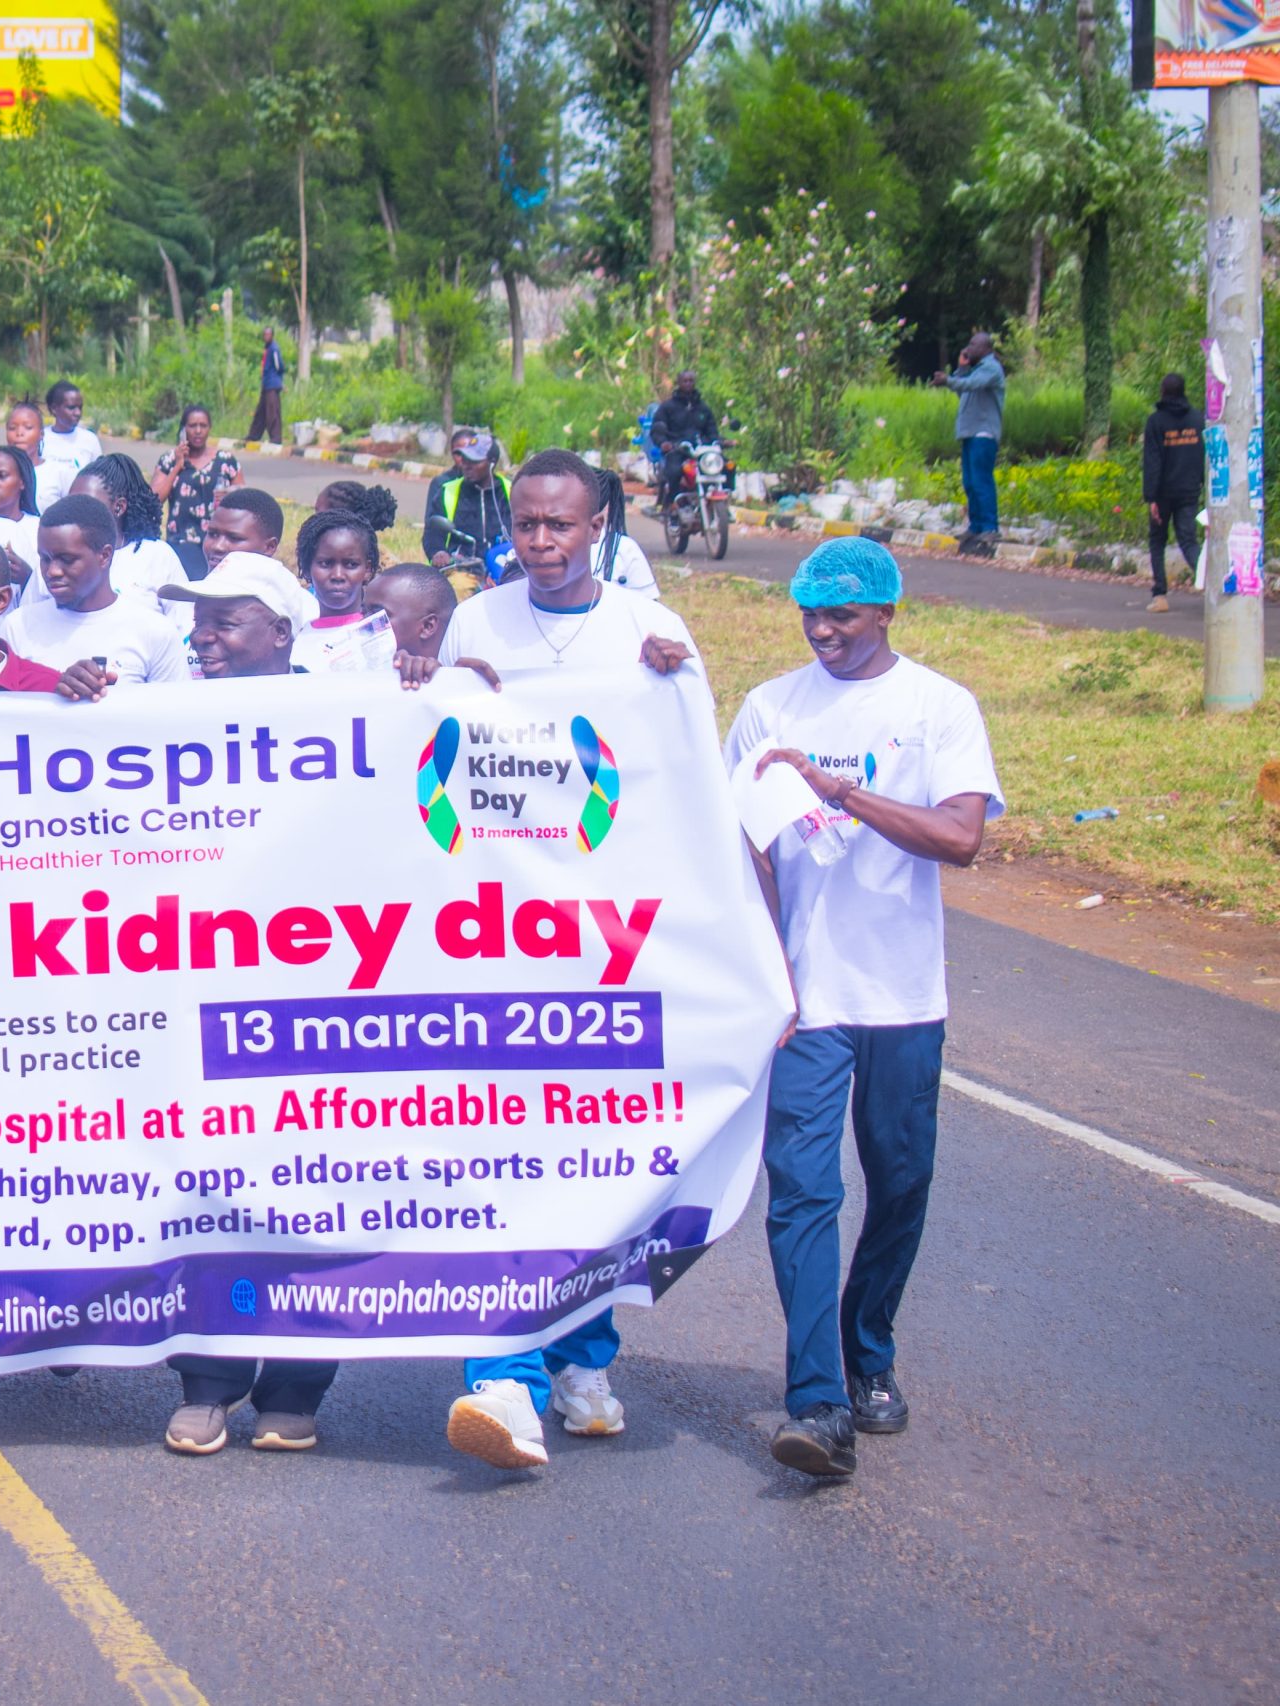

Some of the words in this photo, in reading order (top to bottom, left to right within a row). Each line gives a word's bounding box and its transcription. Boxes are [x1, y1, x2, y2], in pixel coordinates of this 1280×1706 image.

[467, 722, 556, 745] World
[468, 753, 573, 784] Kidney
[818, 755, 859, 768] World
[140, 804, 262, 834] Center
[470, 788, 527, 818] Day
[471, 827, 485, 839] 13
[487, 826, 534, 839] march
[535, 827, 569, 839] 2025
[0, 850, 103, 872] Healthier
[110, 846, 225, 868] Tomorrow
[10, 889, 413, 990] kidney
[434, 881, 663, 985] day
[66, 1010, 99, 1034] to
[107, 1009, 169, 1032] care
[219, 1009, 276, 1055] 13
[293, 1003, 489, 1052] march
[504, 1001, 645, 1046] 2025
[19, 1043, 142, 1078] practice
[142, 1099, 185, 1140] at
[201, 1102, 256, 1137] an
[274, 1083, 528, 1133] Affordable
[543, 1081, 686, 1125] Rate!!
[174, 1164, 258, 1198] opp.
[271, 1153, 410, 1187] eldoret
[423, 1151, 544, 1188] sports
[557, 1147, 635, 1179] club
[647, 1145, 680, 1176] &
[2, 1217, 52, 1252] rd,
[64, 1220, 146, 1252] opp.
[159, 1202, 346, 1242] medi-heal
[360, 1199, 508, 1233] eldoret.
[266, 1235, 672, 1325] www.raphahospitalkenya.com
[86, 1283, 187, 1323] eldoret
